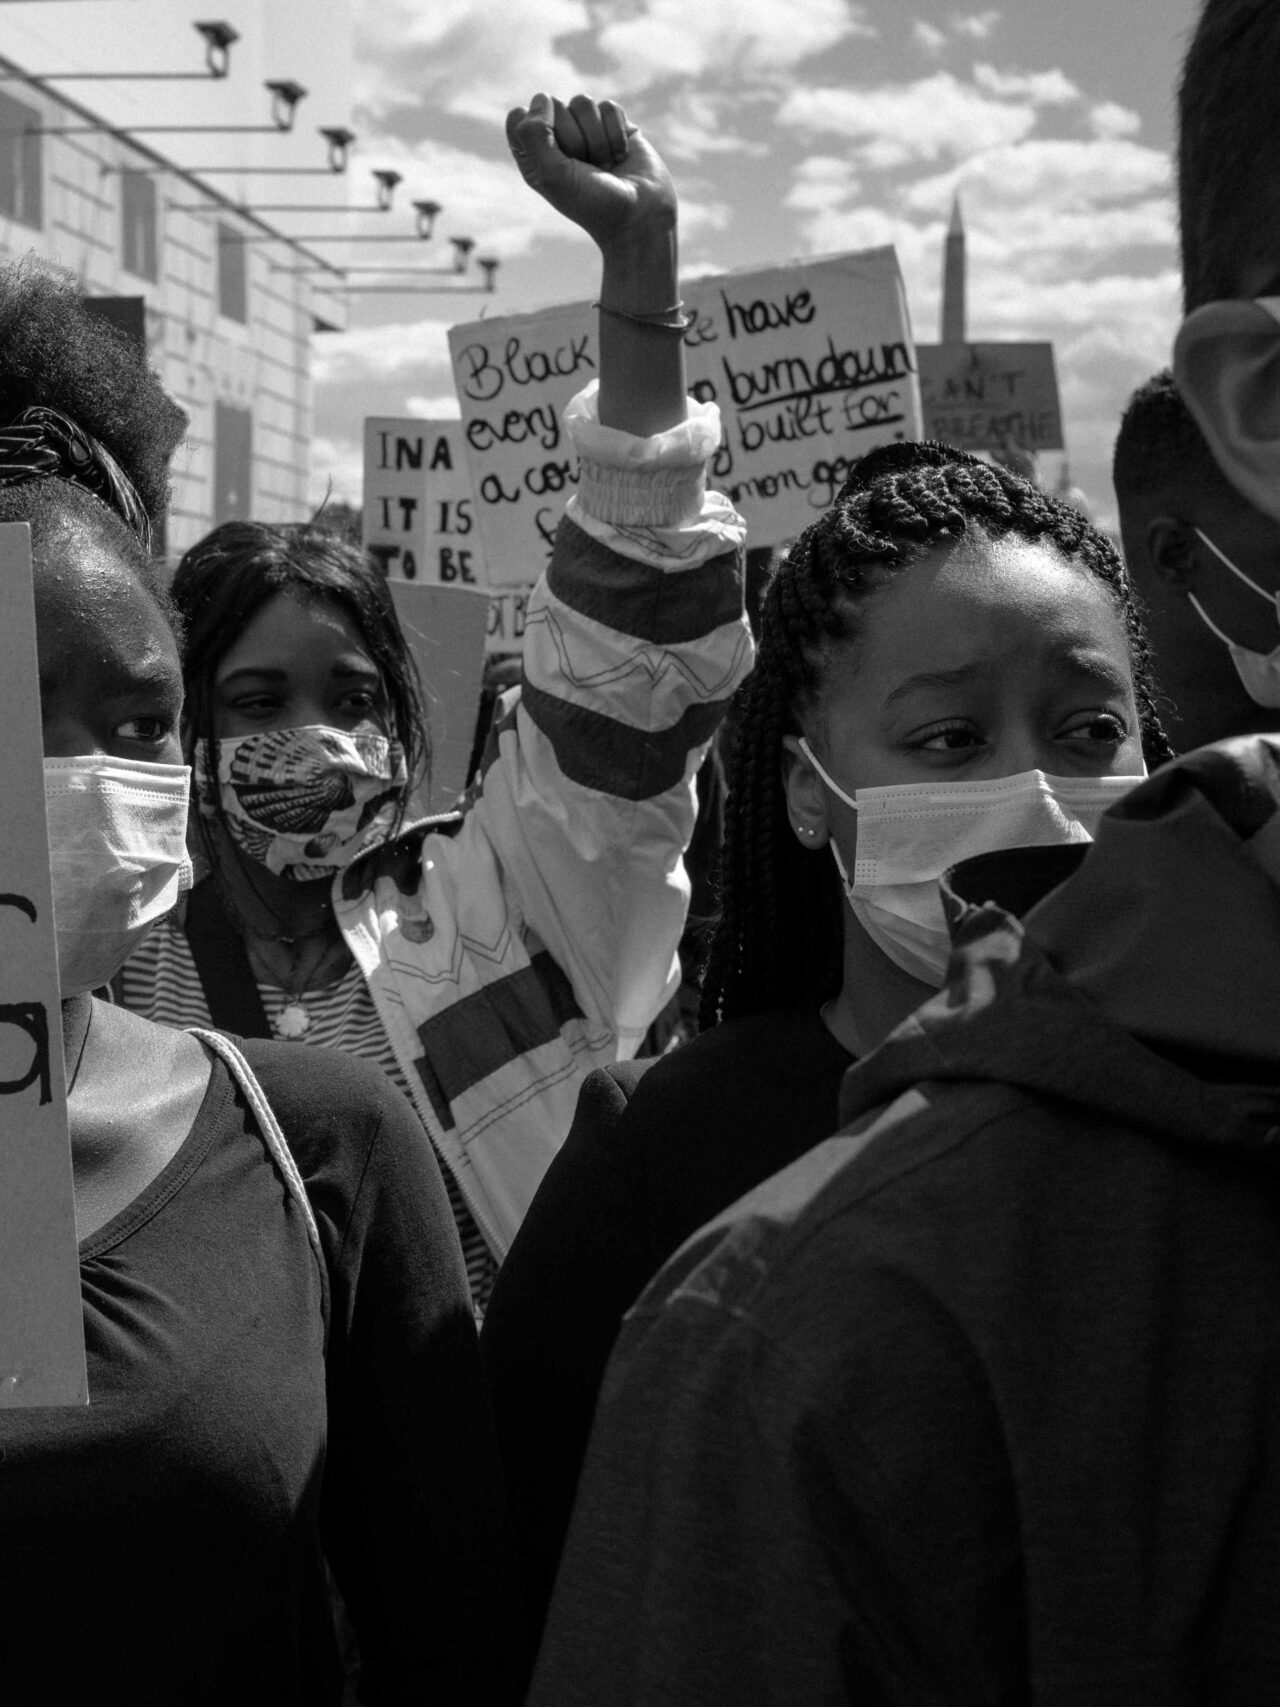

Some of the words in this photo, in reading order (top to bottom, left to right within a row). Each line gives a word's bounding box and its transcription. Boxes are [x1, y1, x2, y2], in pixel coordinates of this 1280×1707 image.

[458, 336, 595, 401] Black
[719, 288, 816, 339] have
[467, 403, 560, 451] every
[722, 356, 815, 405] burn
[816, 334, 914, 391] down
[377, 431, 423, 471] IN
[430, 436, 453, 471] A
[481, 473, 520, 504] a
[737, 394, 834, 451] built
[843, 389, 901, 424] for
[379, 497, 418, 531] IT
[436, 500, 473, 534] IS
[368, 544, 417, 581] TO
[439, 547, 476, 585] BE
